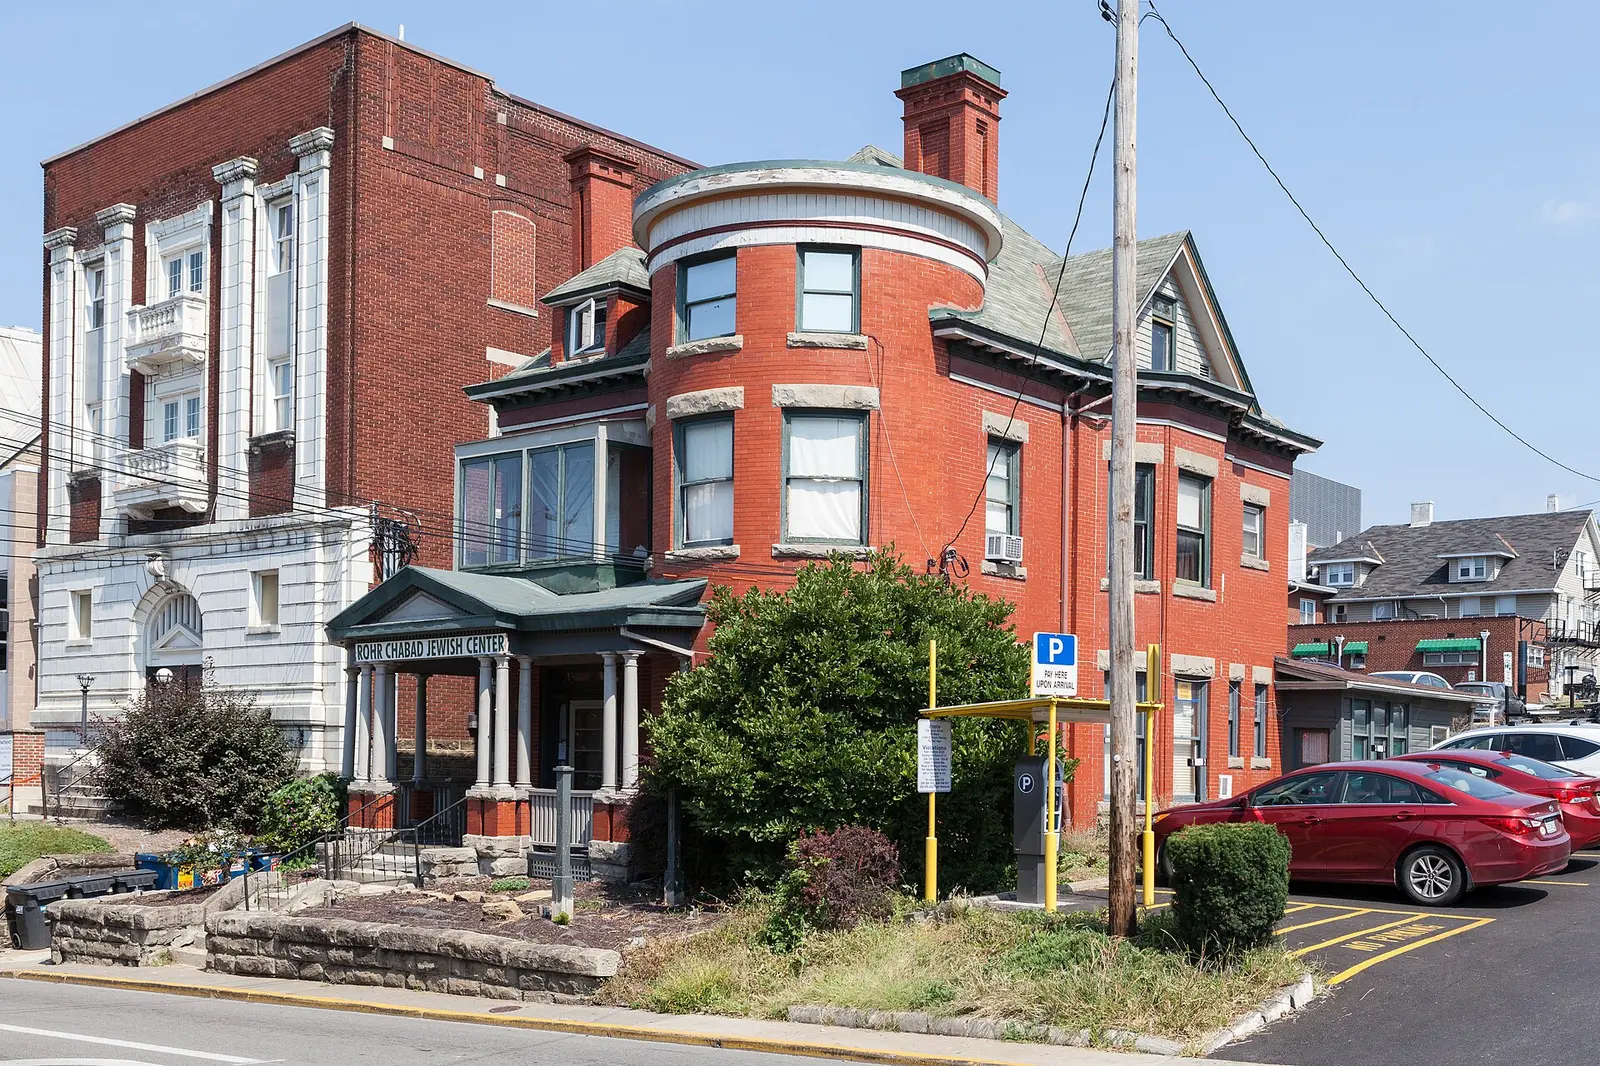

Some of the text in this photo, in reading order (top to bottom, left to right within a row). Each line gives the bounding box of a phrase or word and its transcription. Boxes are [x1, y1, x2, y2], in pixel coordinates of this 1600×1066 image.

[357, 634, 505, 661] ROHR CHABAD JEWISH CENTER
[1048, 637, 1064, 663] P
[1036, 680, 1075, 690] UPON ARRIVAL
[1044, 670, 1068, 680] PAY HERE
[1022, 776, 1031, 790] P
[1341, 924, 1445, 951] NO PARKING
